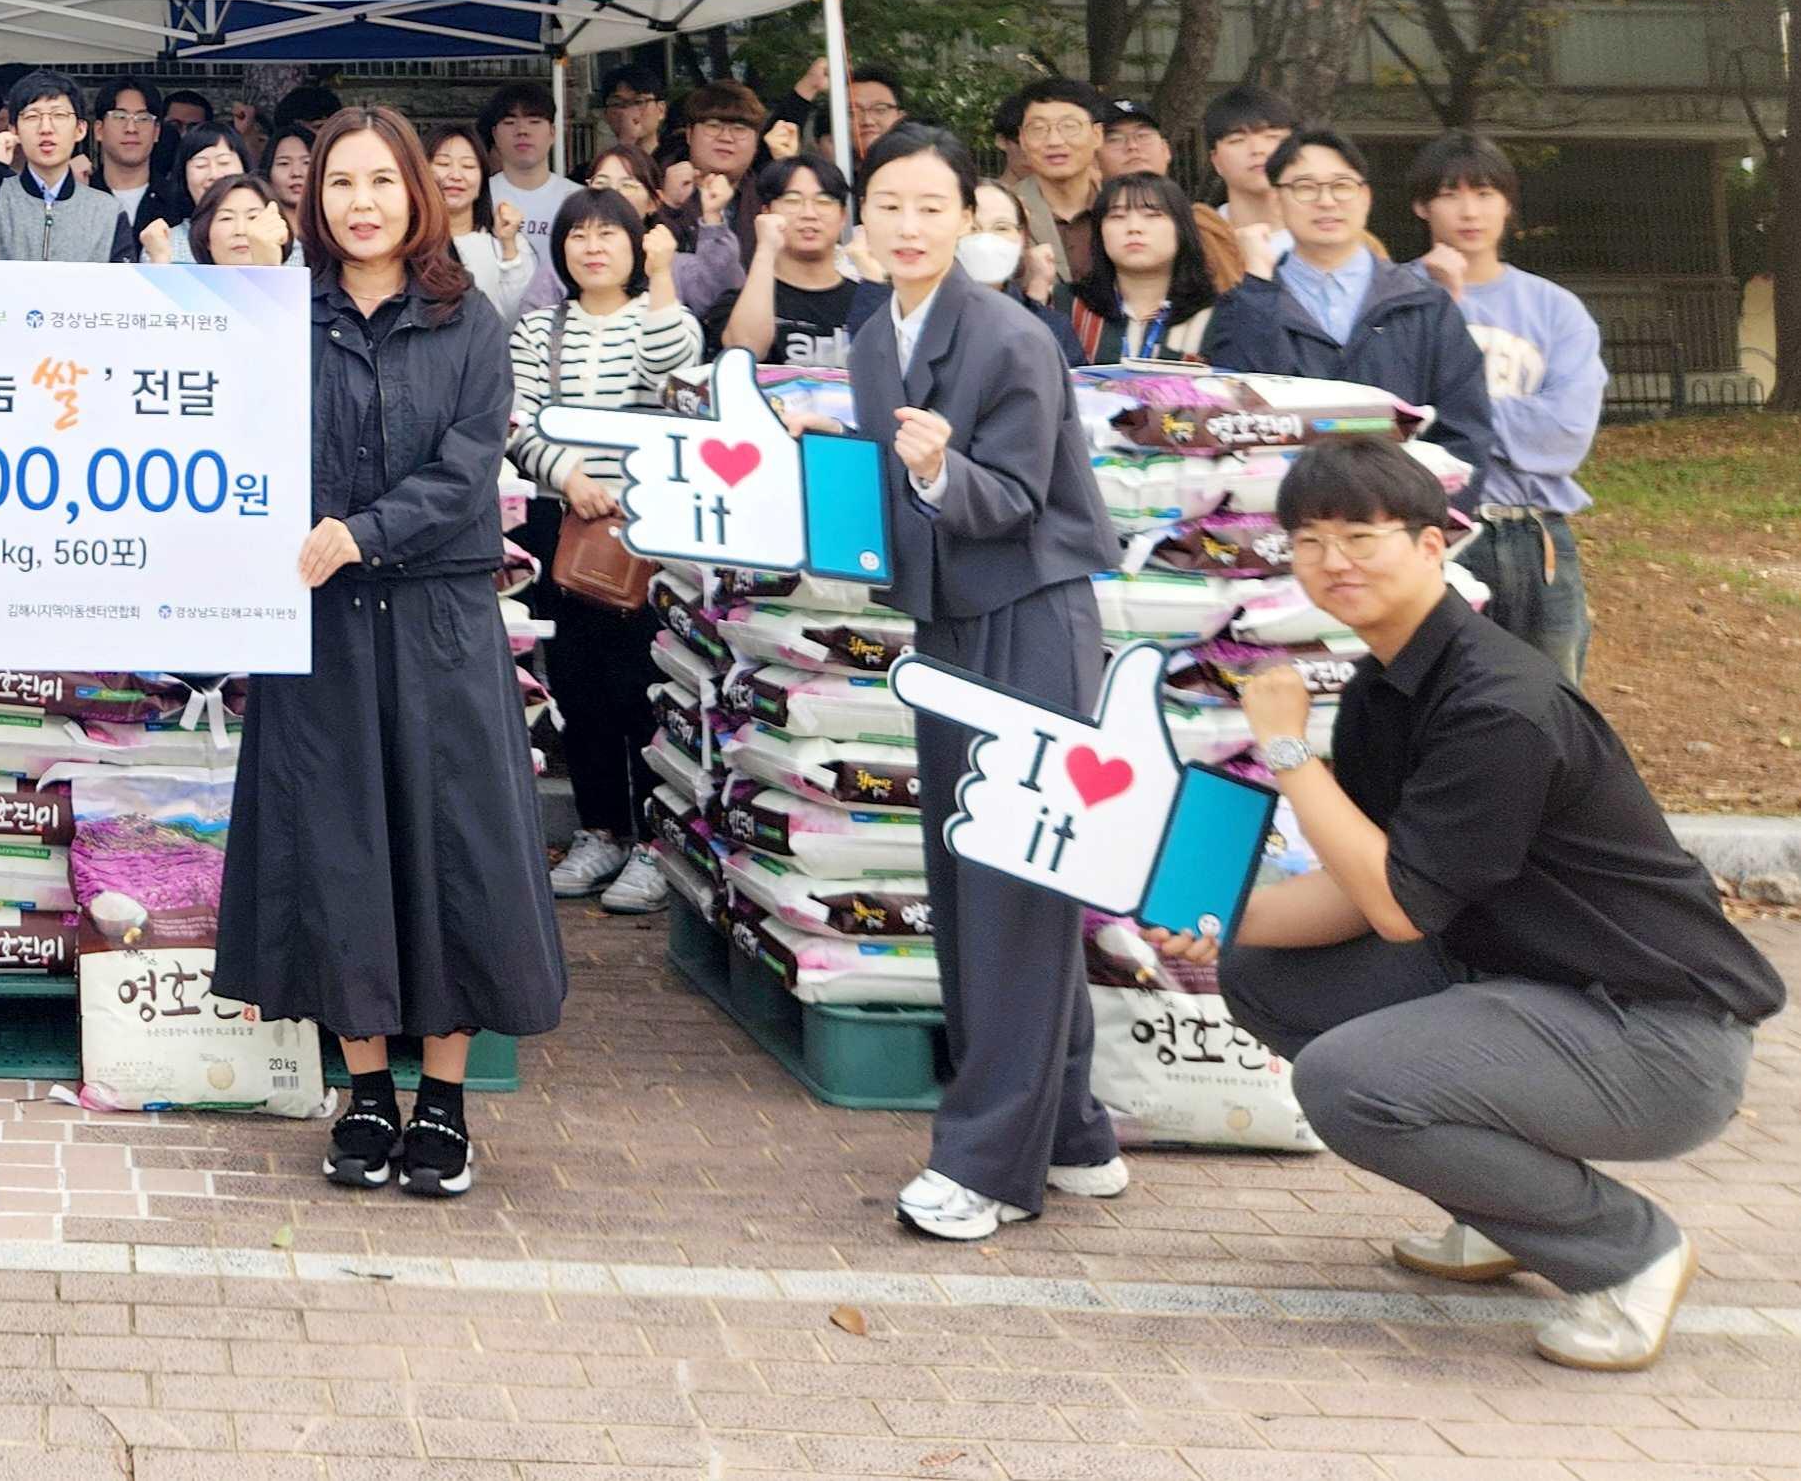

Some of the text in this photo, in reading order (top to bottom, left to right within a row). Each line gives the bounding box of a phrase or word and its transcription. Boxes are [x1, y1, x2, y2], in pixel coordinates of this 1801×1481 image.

[50, 311, 228, 332] 경상남도김해교육지원청
[131, 368, 219, 416] 전달
[666, 433, 689, 483] I
[693, 493, 731, 545] it
[54, 535, 147, 569] 560포)
[8, 604, 140, 620] 김해시지역아동센터연합회
[175, 606, 297, 620] 경상남도김해교육지원청
[1019, 730, 1056, 793] I
[1025, 806, 1075, 872] it
[118, 960, 241, 1022] 영호
